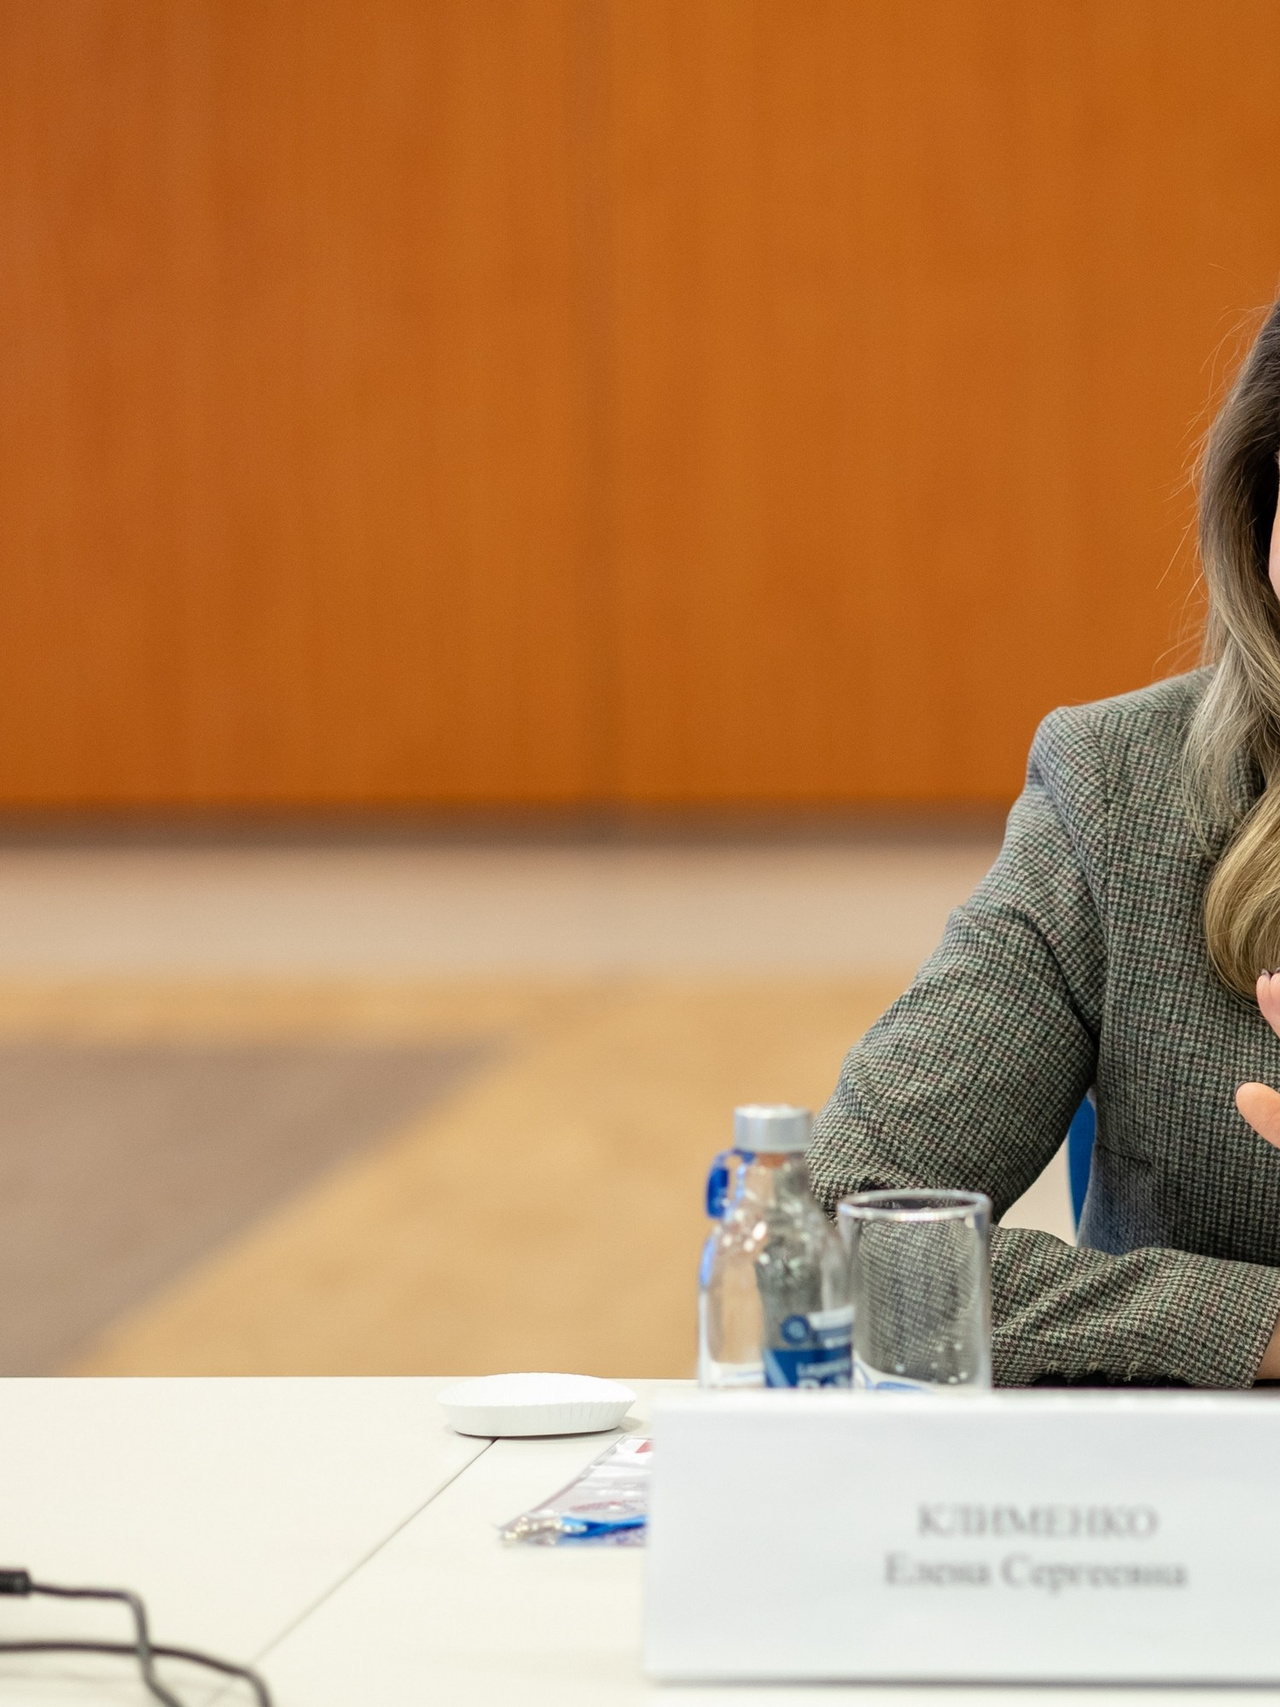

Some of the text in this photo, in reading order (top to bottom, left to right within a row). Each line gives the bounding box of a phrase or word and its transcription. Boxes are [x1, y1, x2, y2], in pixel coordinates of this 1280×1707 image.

[917, 1502, 1159, 1537] КЛИМЕНКО
[884, 1552, 1188, 1595] Елена Сергеевна
